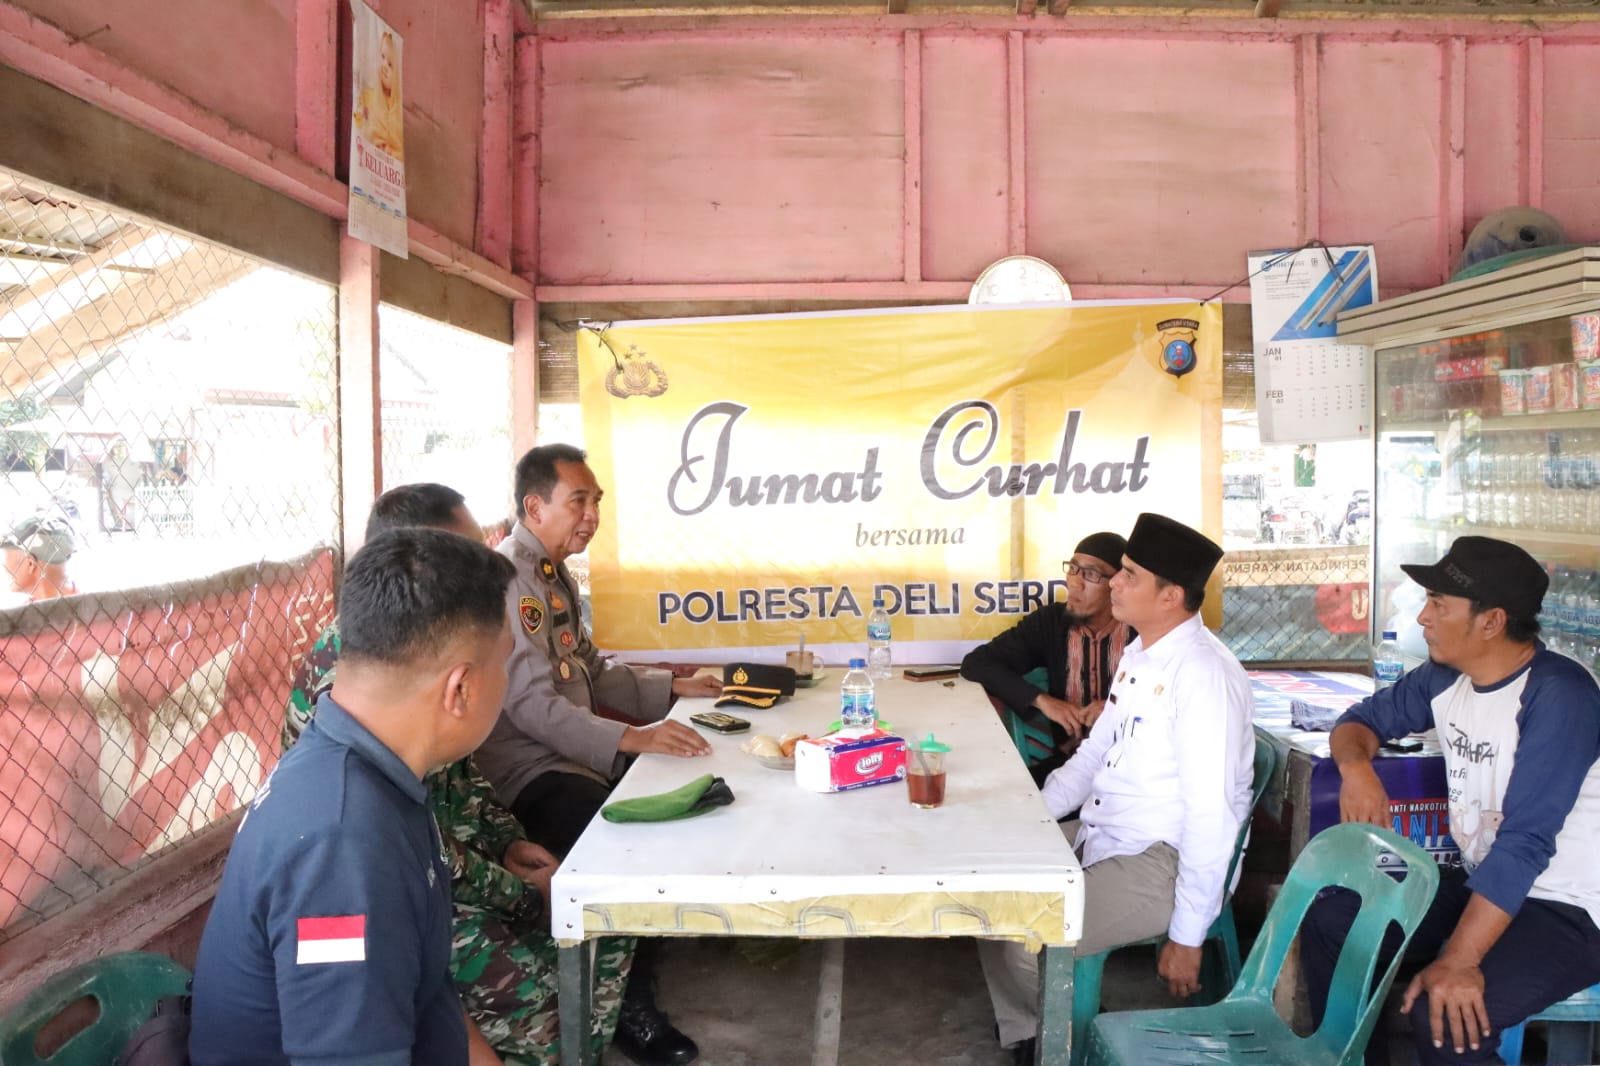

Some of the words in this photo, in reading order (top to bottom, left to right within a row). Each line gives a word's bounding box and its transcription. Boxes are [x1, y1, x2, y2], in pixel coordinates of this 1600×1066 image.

[1264, 347, 1281, 356] JAN
[1265, 390, 1284, 399] FEB
[667, 402, 883, 516] Jumat
[920, 400, 1150, 500] Curhat
[855, 522, 965, 548] bersama
[659, 587, 862, 623] POLRESTA
[875, 583, 959, 615] DELI
[1389, 804, 1407, 813] ANTI
